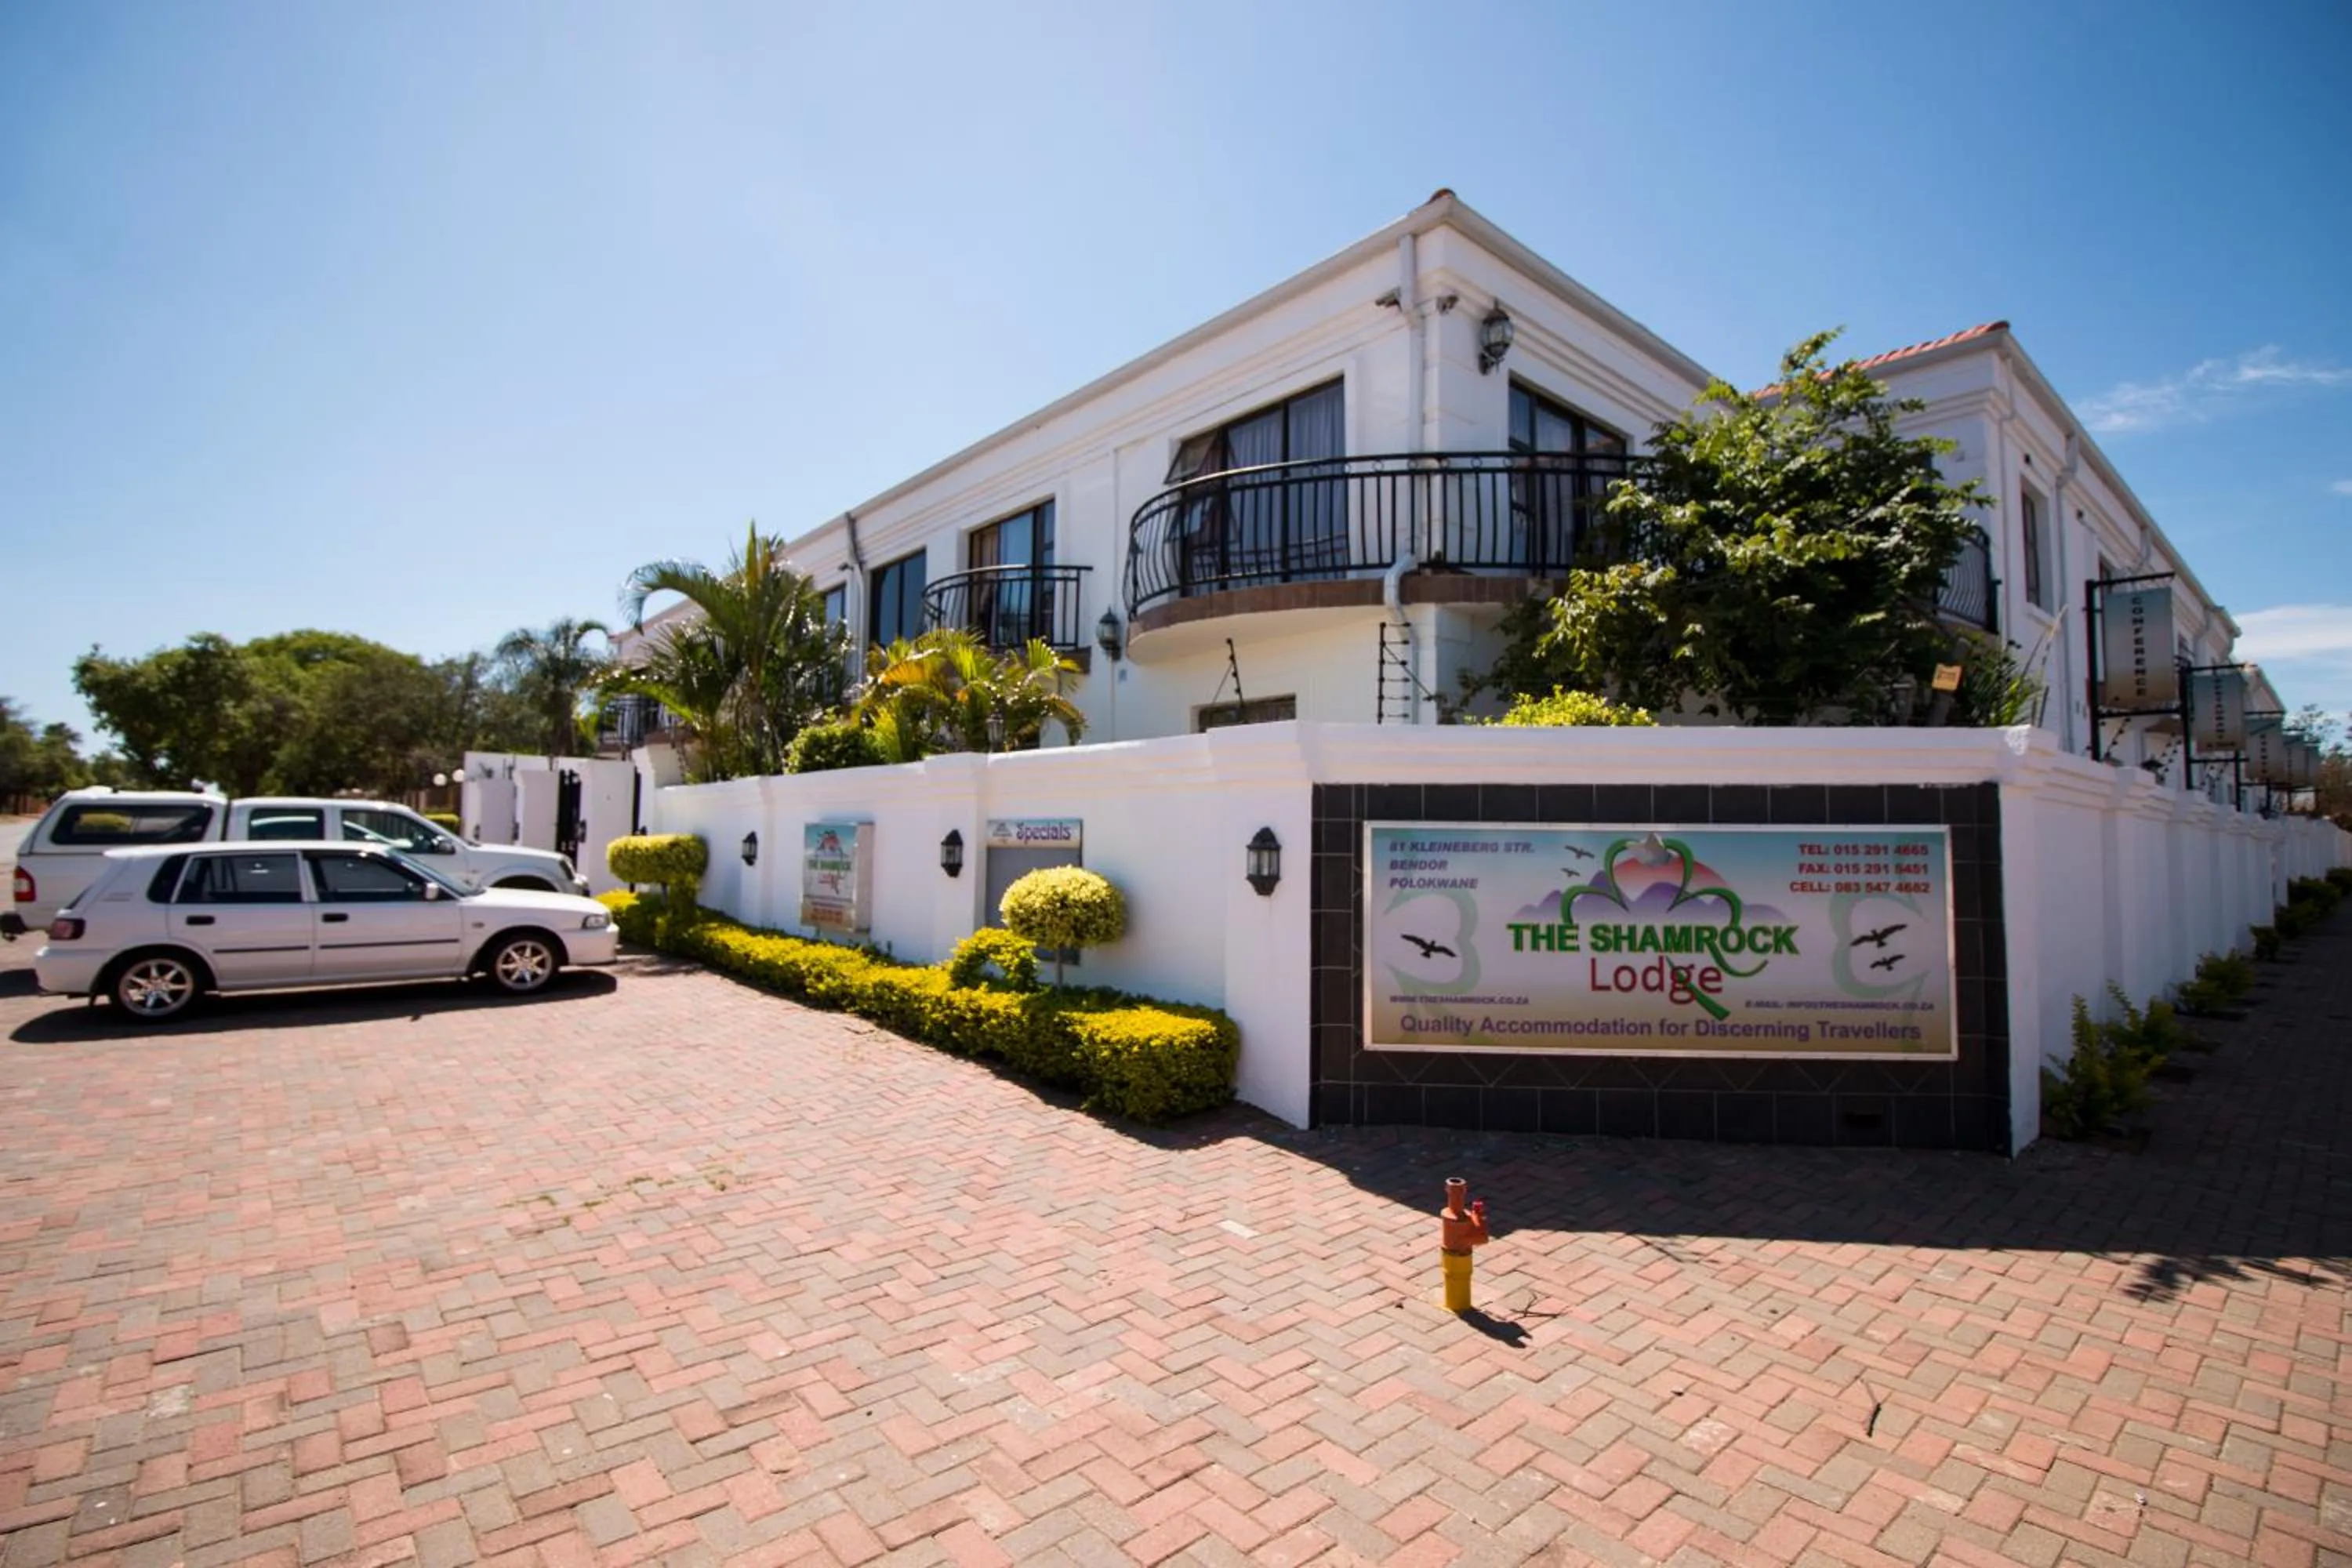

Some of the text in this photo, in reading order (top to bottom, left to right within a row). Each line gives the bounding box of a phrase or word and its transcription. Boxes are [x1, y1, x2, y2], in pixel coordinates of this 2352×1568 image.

[1016, 821, 1071, 844] Specials
[1798, 844, 1829, 855] TEL:
[1834, 844, 1859, 855] 015
[1390, 859, 1448, 870] BENDOR
[1798, 863, 1829, 874] FAX:
[1834, 863, 1860, 875] 015
[1390, 877, 1479, 889] POLOKWANE
[1789, 881, 1831, 892] CELL:
[1506, 924, 1801, 956] THE SHAMROCK
[1591, 956, 1722, 1005] Lodge
[1401, 1014, 1921, 1041] Quality Accommodation for Discerning Travellers
